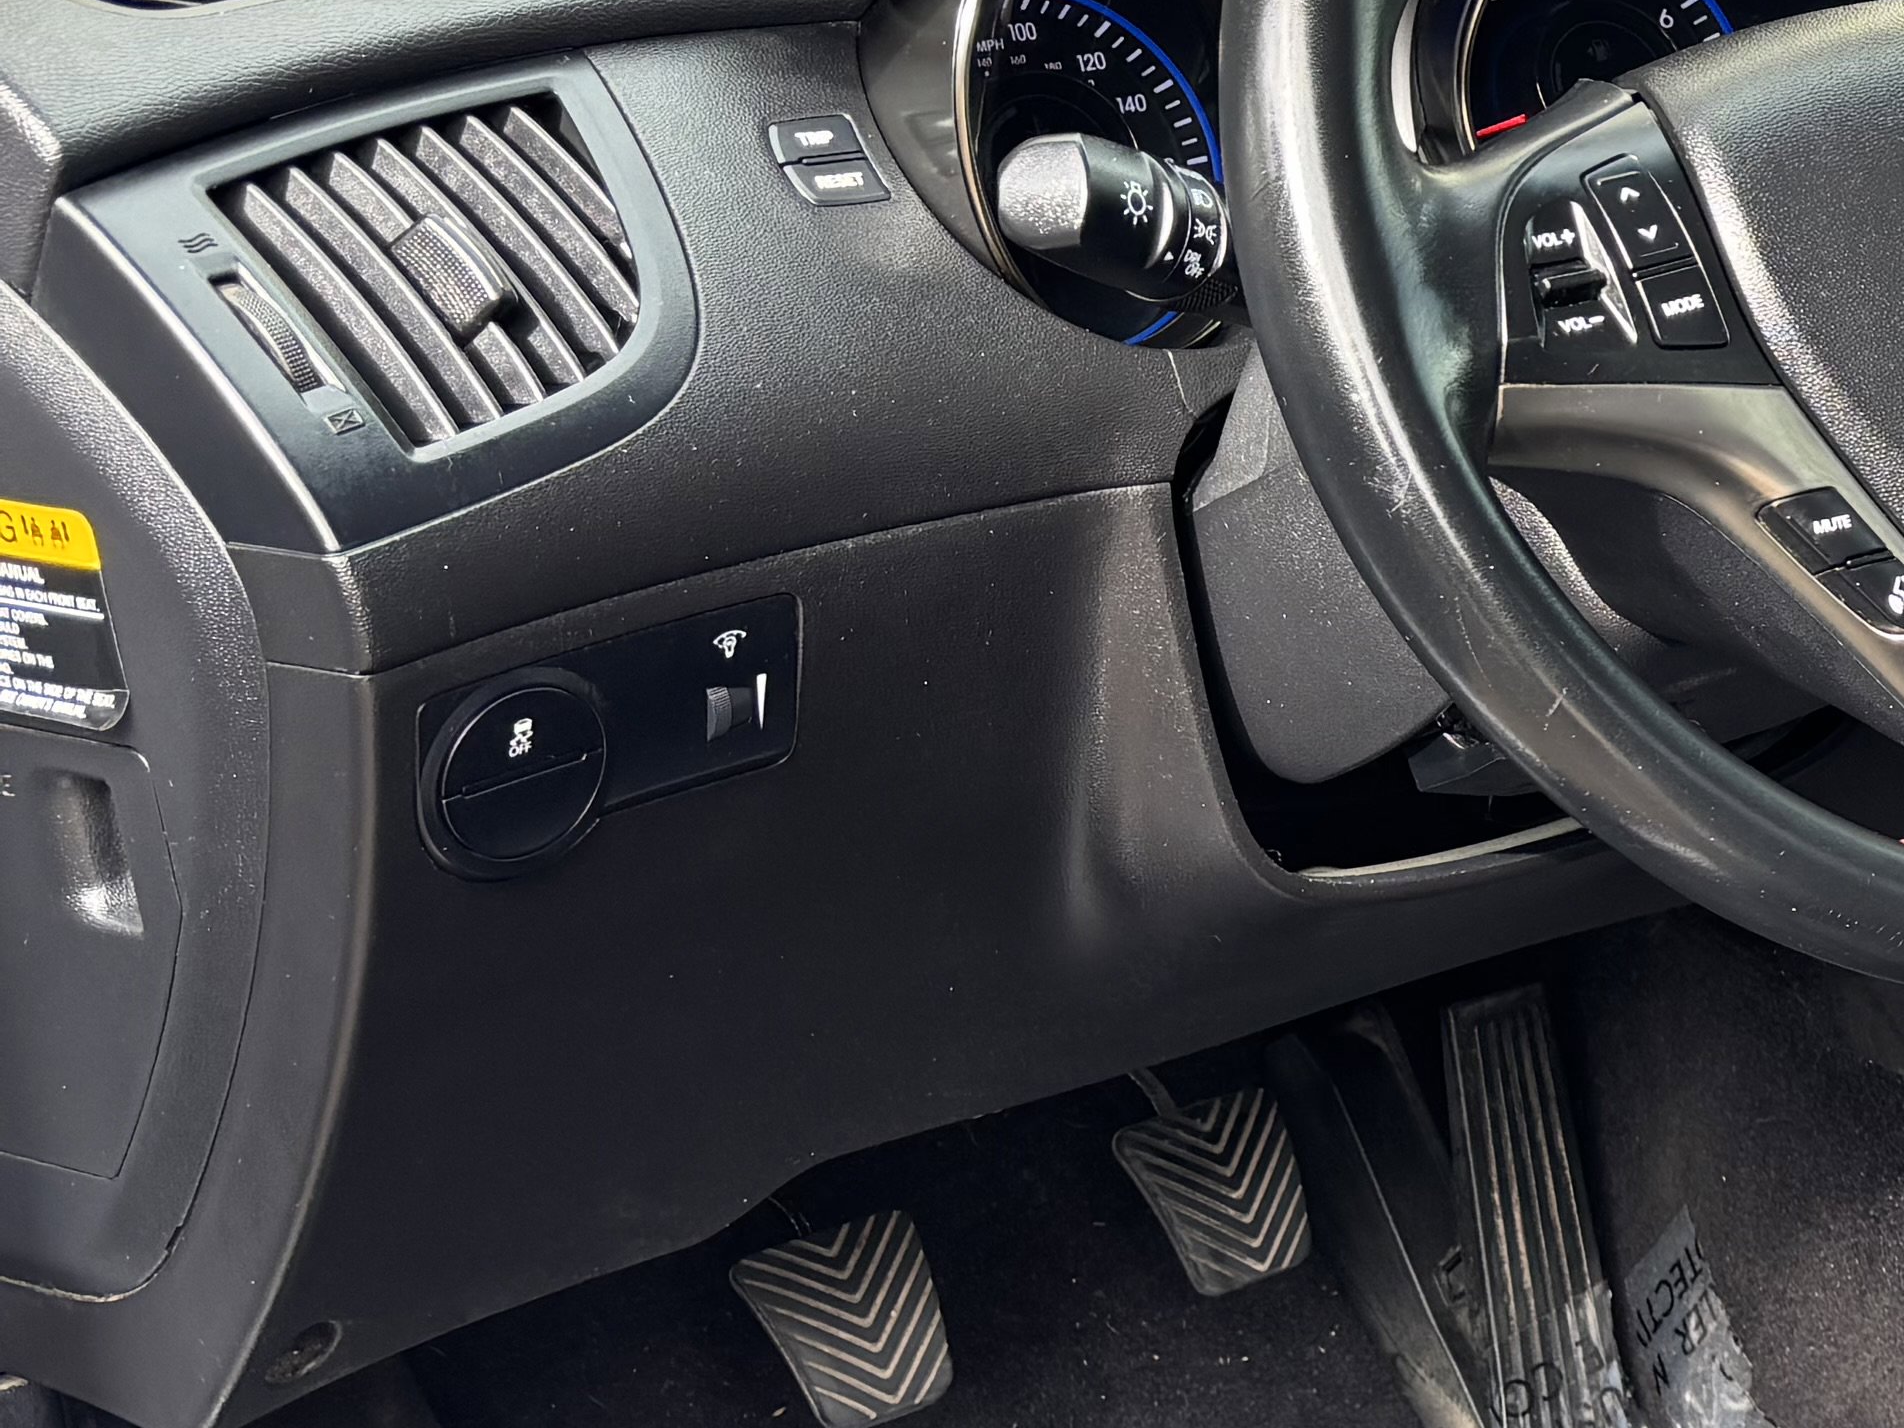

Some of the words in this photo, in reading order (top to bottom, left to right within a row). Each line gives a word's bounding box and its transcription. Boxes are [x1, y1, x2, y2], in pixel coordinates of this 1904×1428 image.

[1659, 8, 1674, 28] 6
[1007, 21, 1038, 42] 100
[976, 37, 1005, 53] MPH
[1076, 51, 1107, 73] 120
[1115, 93, 1147, 115] 140
[1661, 292, 1705, 317] MODE
[1812, 514, 1853, 534] MUTE
[509, 741, 532, 758] OFF
